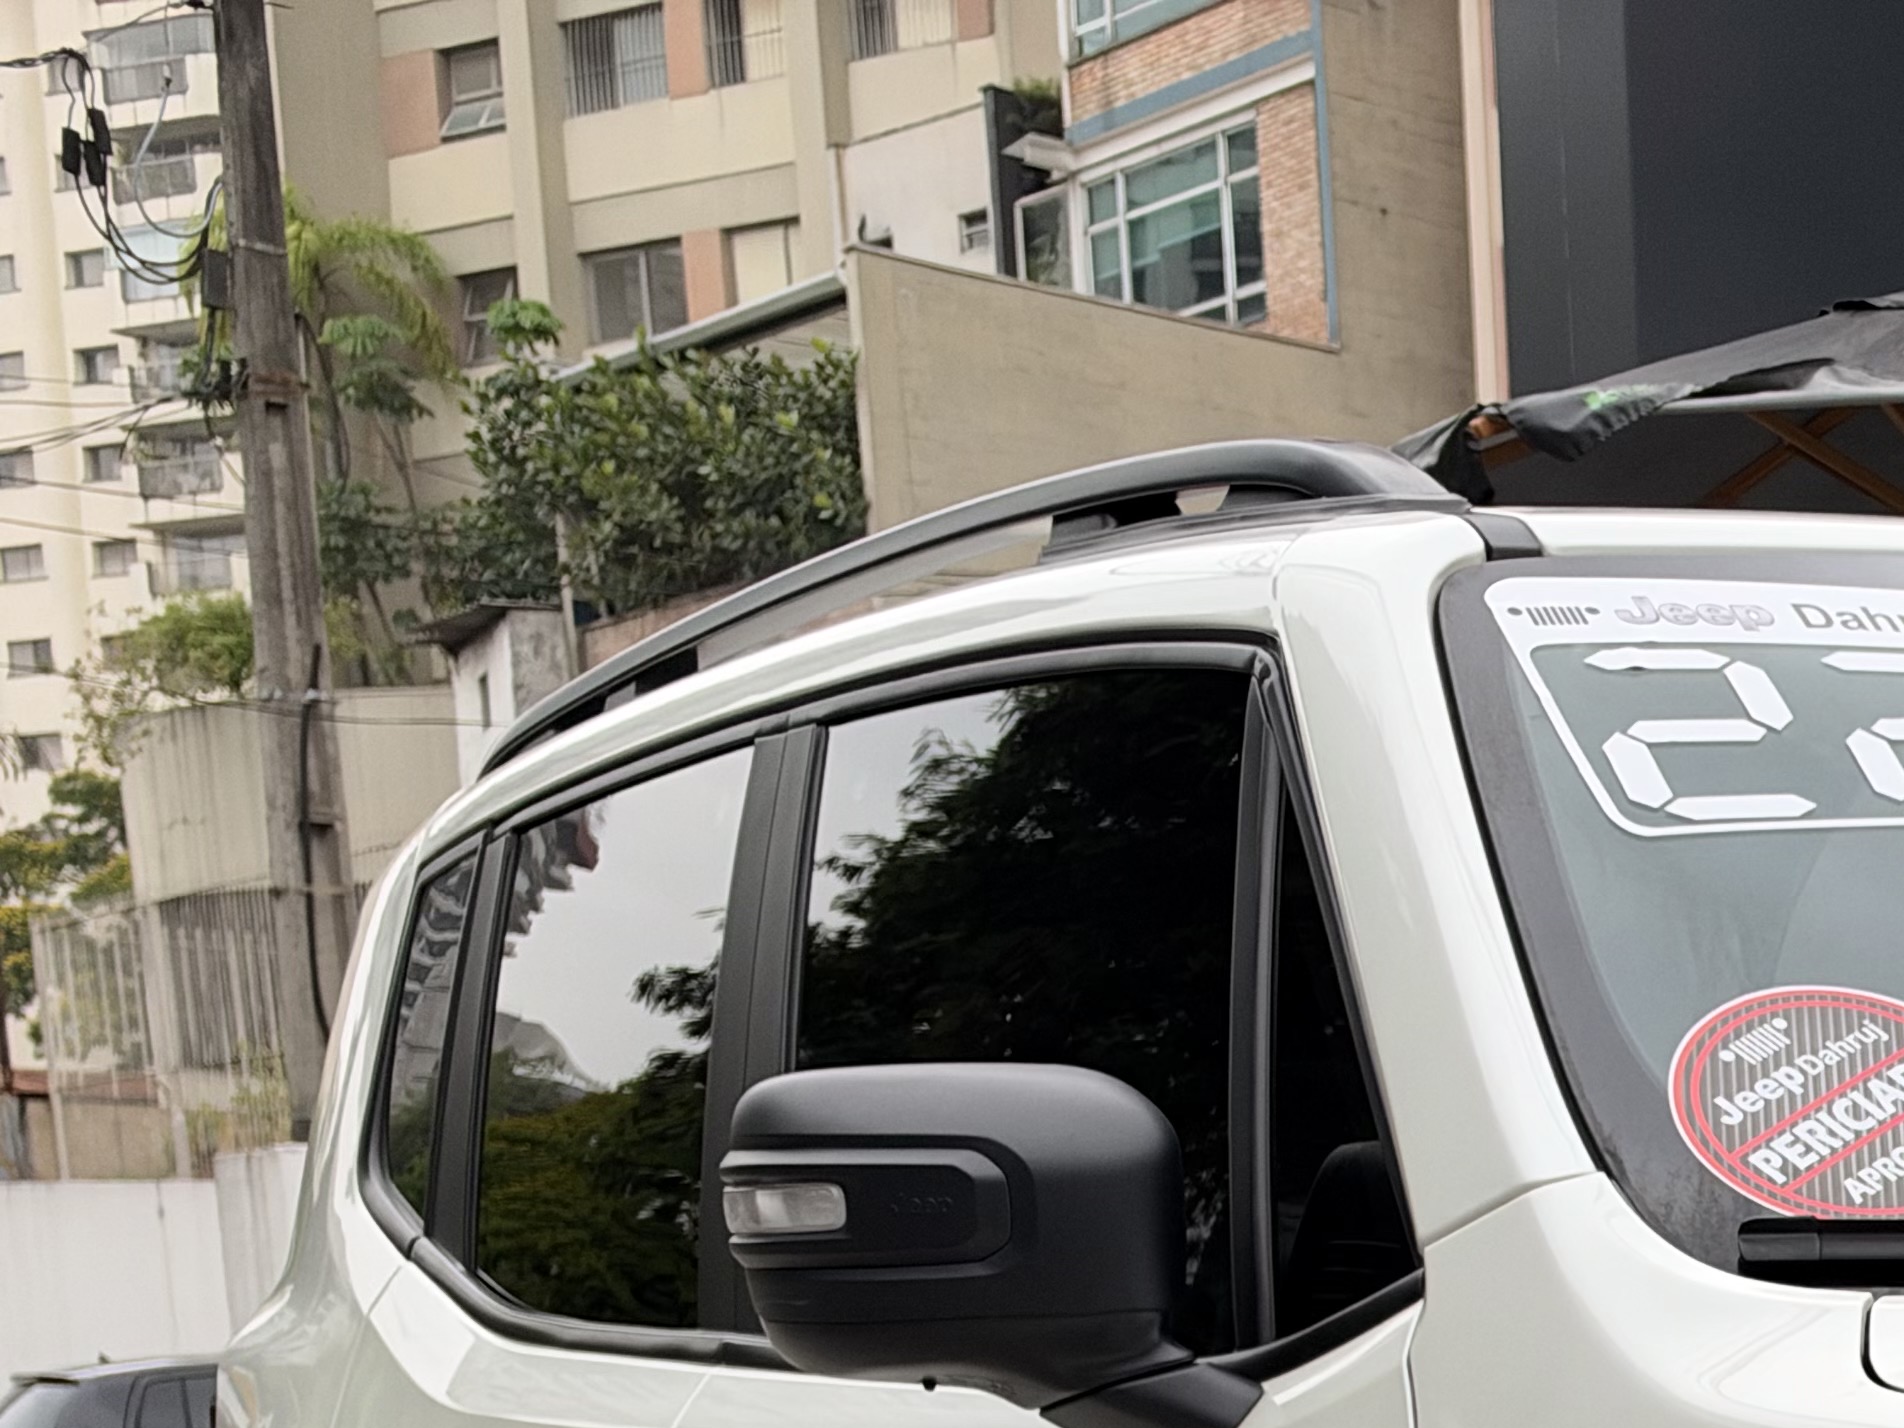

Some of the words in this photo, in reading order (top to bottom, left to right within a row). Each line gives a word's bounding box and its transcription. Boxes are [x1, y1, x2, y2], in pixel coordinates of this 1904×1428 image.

[1615, 596, 1775, 632] Jeep
[1713, 1066, 1805, 1126] Jeep
[1794, 1019, 1890, 1077] Dahruj
